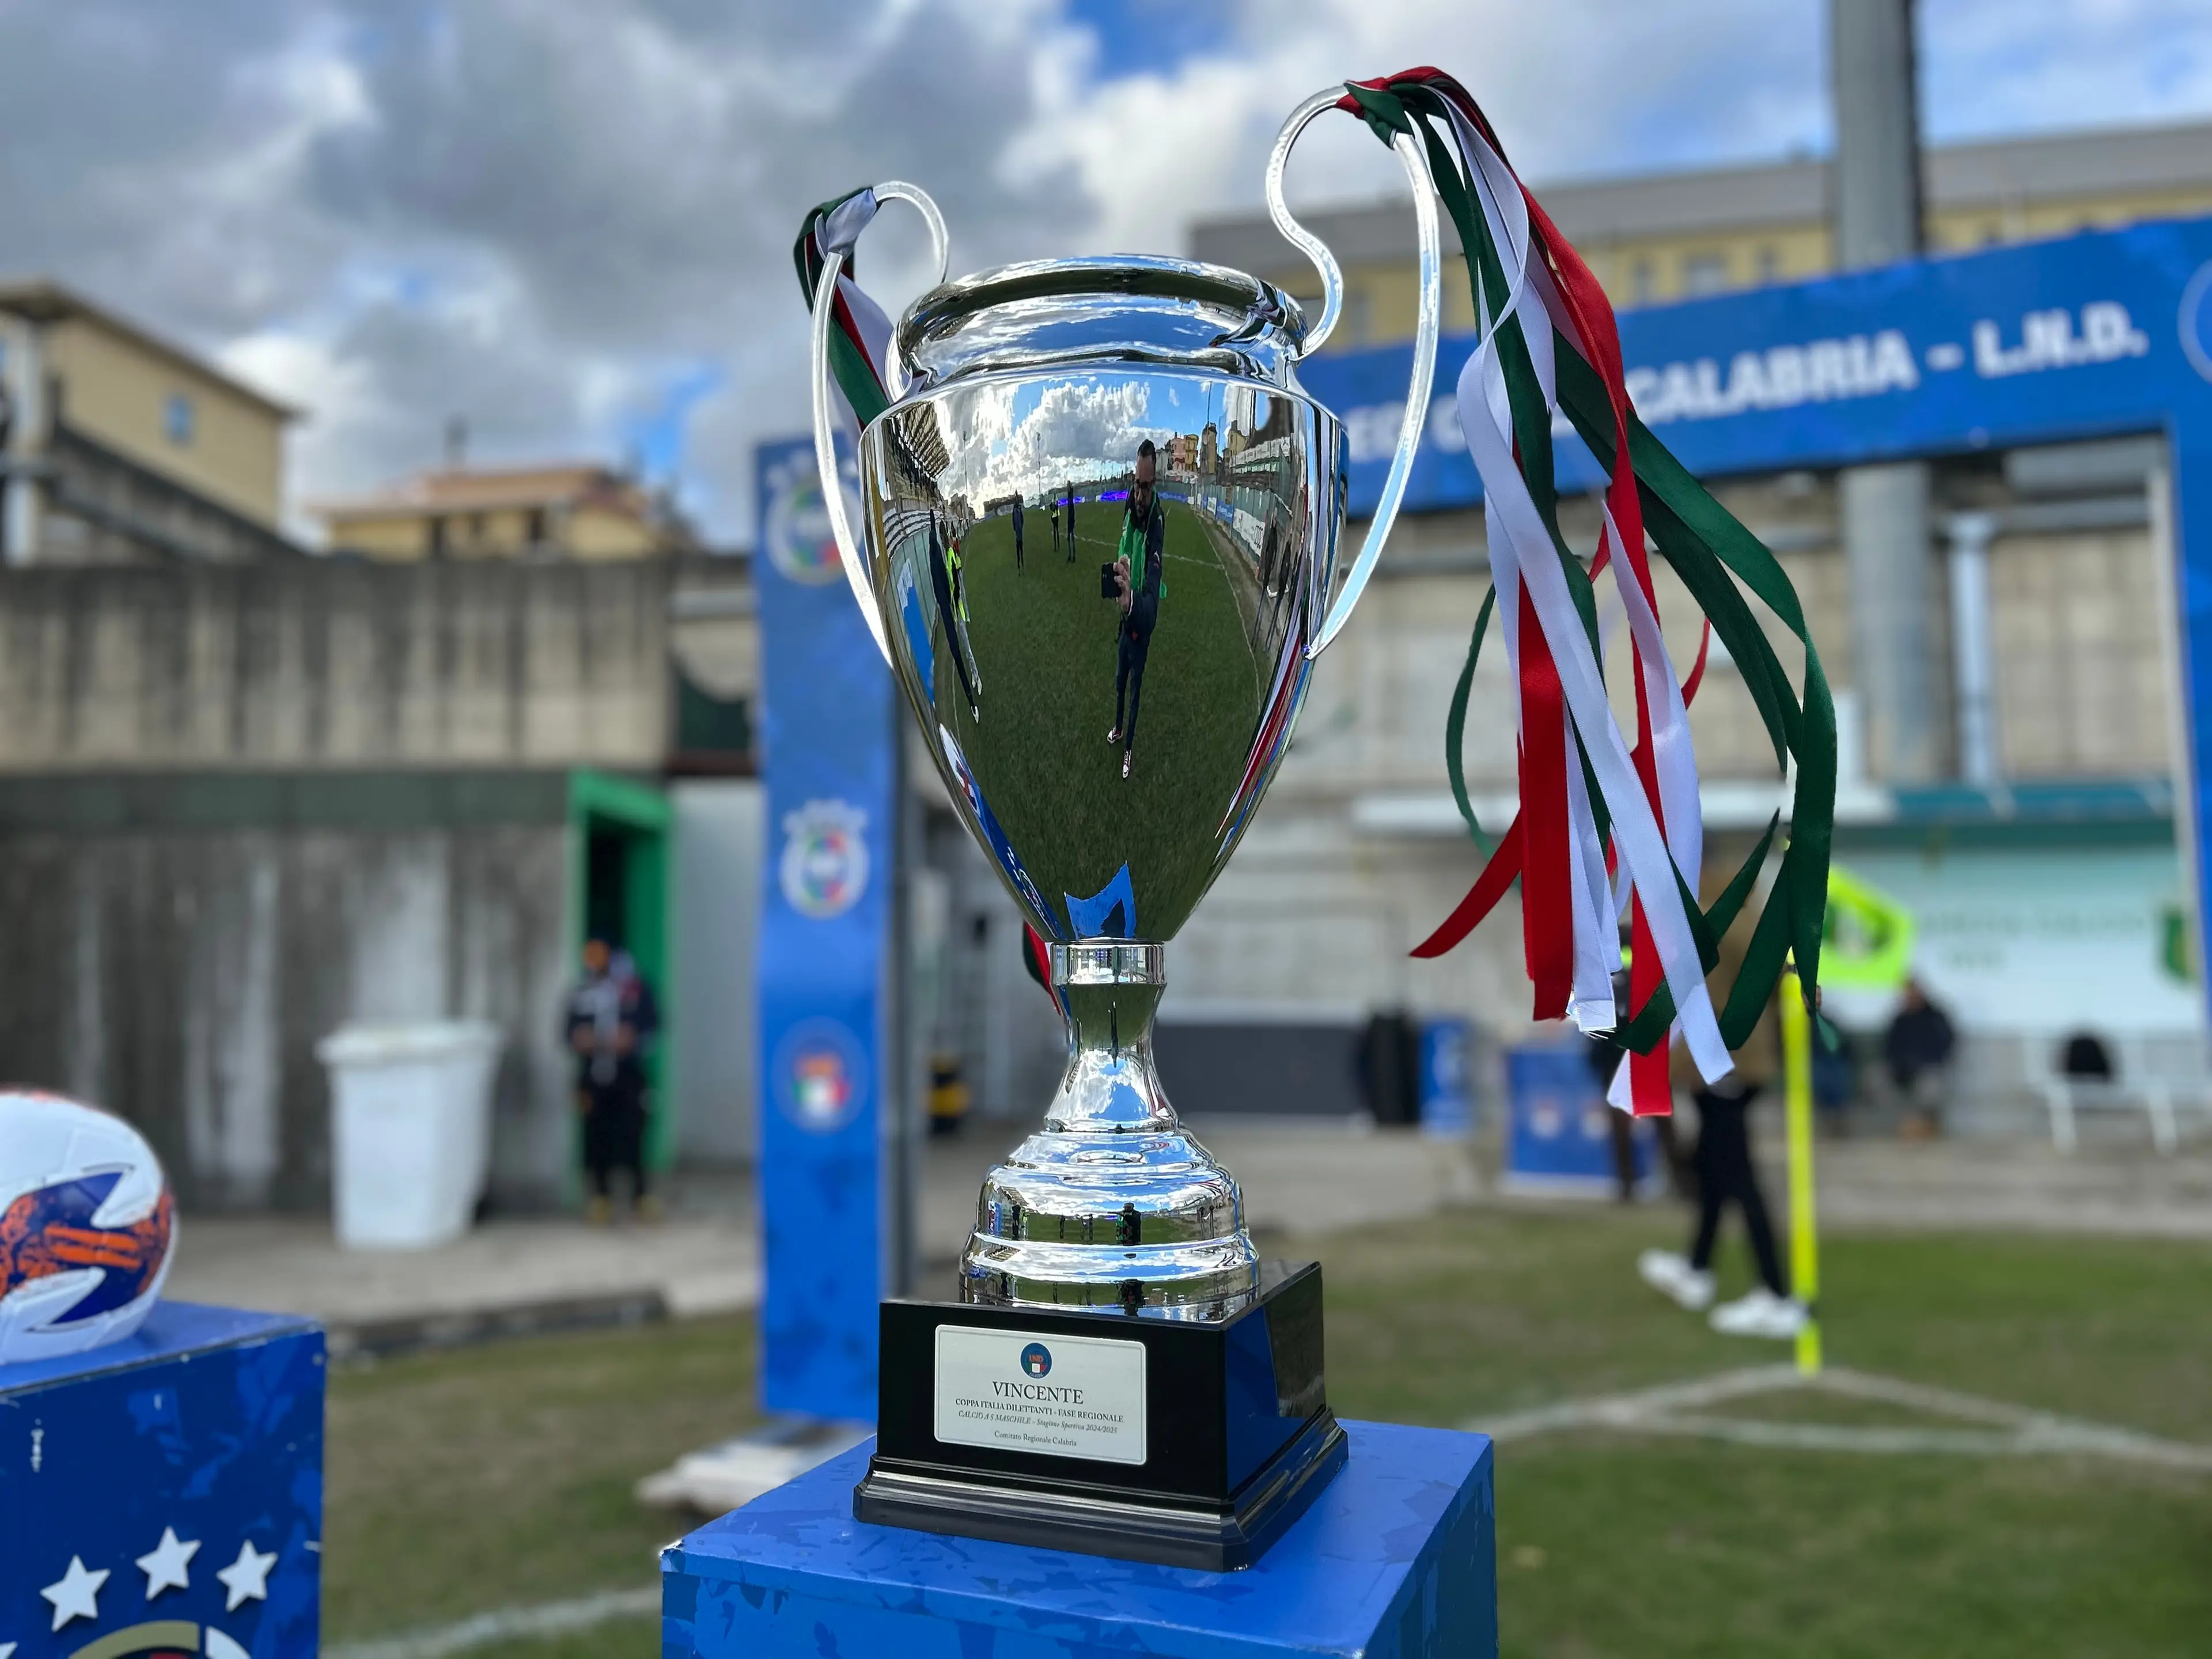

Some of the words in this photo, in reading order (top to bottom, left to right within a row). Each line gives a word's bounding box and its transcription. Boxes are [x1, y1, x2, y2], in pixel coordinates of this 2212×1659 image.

[1626, 331, 1919, 426] CALABRIA
[1974, 301, 2149, 378] L.N.D.
[993, 1381, 1084, 1404] VINCENTE
[956, 1398, 979, 1407] COPPA
[980, 1401, 1005, 1410] ITALIA
[1006, 1403, 1052, 1415] DILETTANTI
[1058, 1409, 1076, 1418] FASE
[1078, 1411, 1124, 1423] REGIONALE
[959, 1410, 983, 1419] CALCIO
[995, 1414, 1031, 1425] MASCHILE
[1037, 1418, 1060, 1428] Stagione
[1061, 1421, 1085, 1430] Sportiva
[1086, 1424, 1118, 1434] 2024/2025
[994, 1430, 1021, 1440] Comitato
[1023, 1433, 1051, 1444] Regionale
[1052, 1437, 1077, 1446] Calabria
